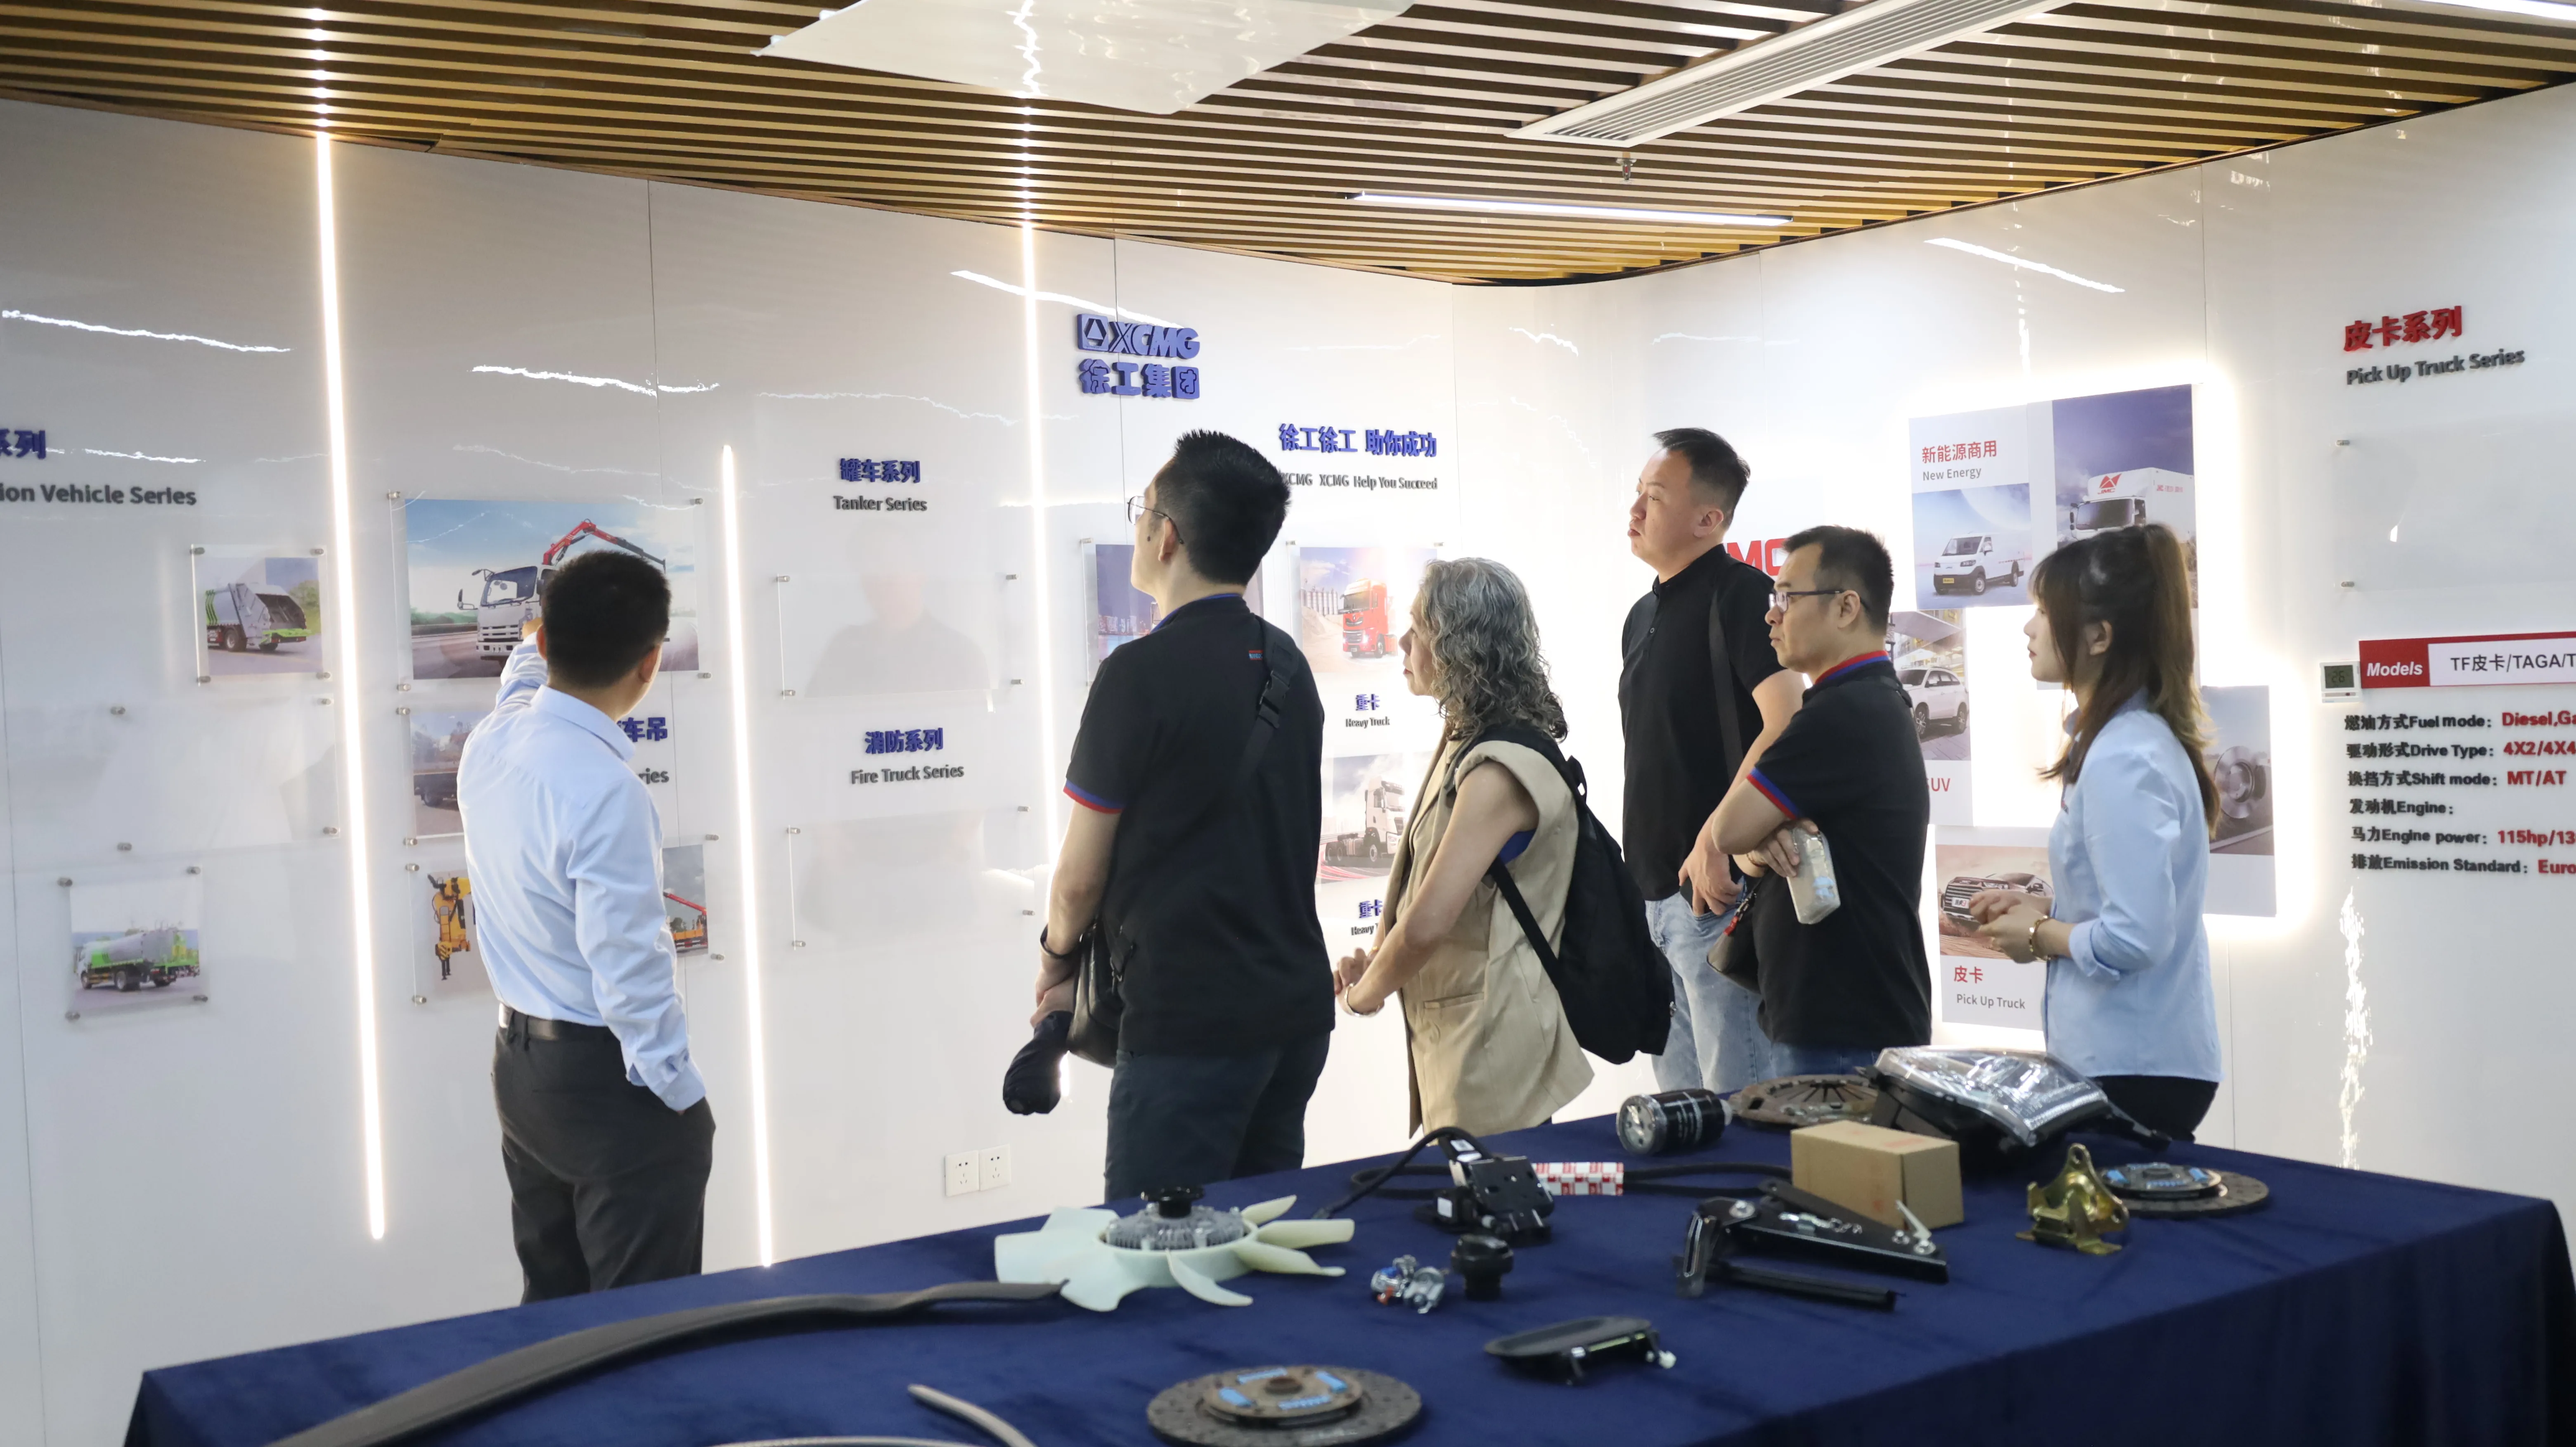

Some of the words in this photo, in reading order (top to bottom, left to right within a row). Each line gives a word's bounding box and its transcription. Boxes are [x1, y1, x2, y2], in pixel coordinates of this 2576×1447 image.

[2343, 306, 2462, 352] 皮卡系列
[1109, 322, 1200, 359] XCMG
[2346, 366, 2383, 385] Pick
[2386, 365, 2411, 382] Up
[2414, 356, 2465, 377] Truck
[2469, 349, 2525, 370] Series
[1079, 358, 1200, 399] 徐工集团
[1279, 423, 1358, 453] 徐工徐工
[1365, 429, 1437, 457] 助你成功
[1922, 440, 1997, 464] 新能源商用
[840, 458, 921, 483] 罐车系列
[1923, 470, 1944, 481] New
[1947, 467, 1982, 479] Energy
[1319, 474, 1349, 488] XCMG
[1353, 475, 1376, 491] Help
[1378, 477, 1397, 489] You
[1398, 477, 1438, 490] Succeed
[40, 484, 124, 504] Vehicle
[129, 487, 197, 505] Series
[833, 495, 883, 511] Tanker
[885, 497, 928, 512] Series
[2366, 662, 2423, 676] Models
[1355, 693, 1380, 711] 重卡
[617, 717, 668, 742] 车吊
[1346, 718, 1369, 729] Heavy
[1369, 716, 1390, 726] Truck
[864, 727, 944, 754] 消防系列
[2346, 742, 2448, 759] 驱动形式Drive
[2504, 740, 2576, 757] 4X2/4X4
[851, 769, 878, 785] Fire
[881, 766, 921, 782] Truck
[923, 764, 965, 780] Series
[2507, 770, 2567, 787] MT/AT
[1925, 778, 1951, 792] UV
[2498, 829, 2576, 847] 115hp/13
[2538, 859, 2576, 874] Euro
[1351, 925, 1374, 935] Heavy
[1953, 965, 1983, 983] 皮卡
[1956, 993, 1977, 1005] Pick
[1980, 996, 1994, 1008] Up
[1997, 997, 2025, 1009] Truck
